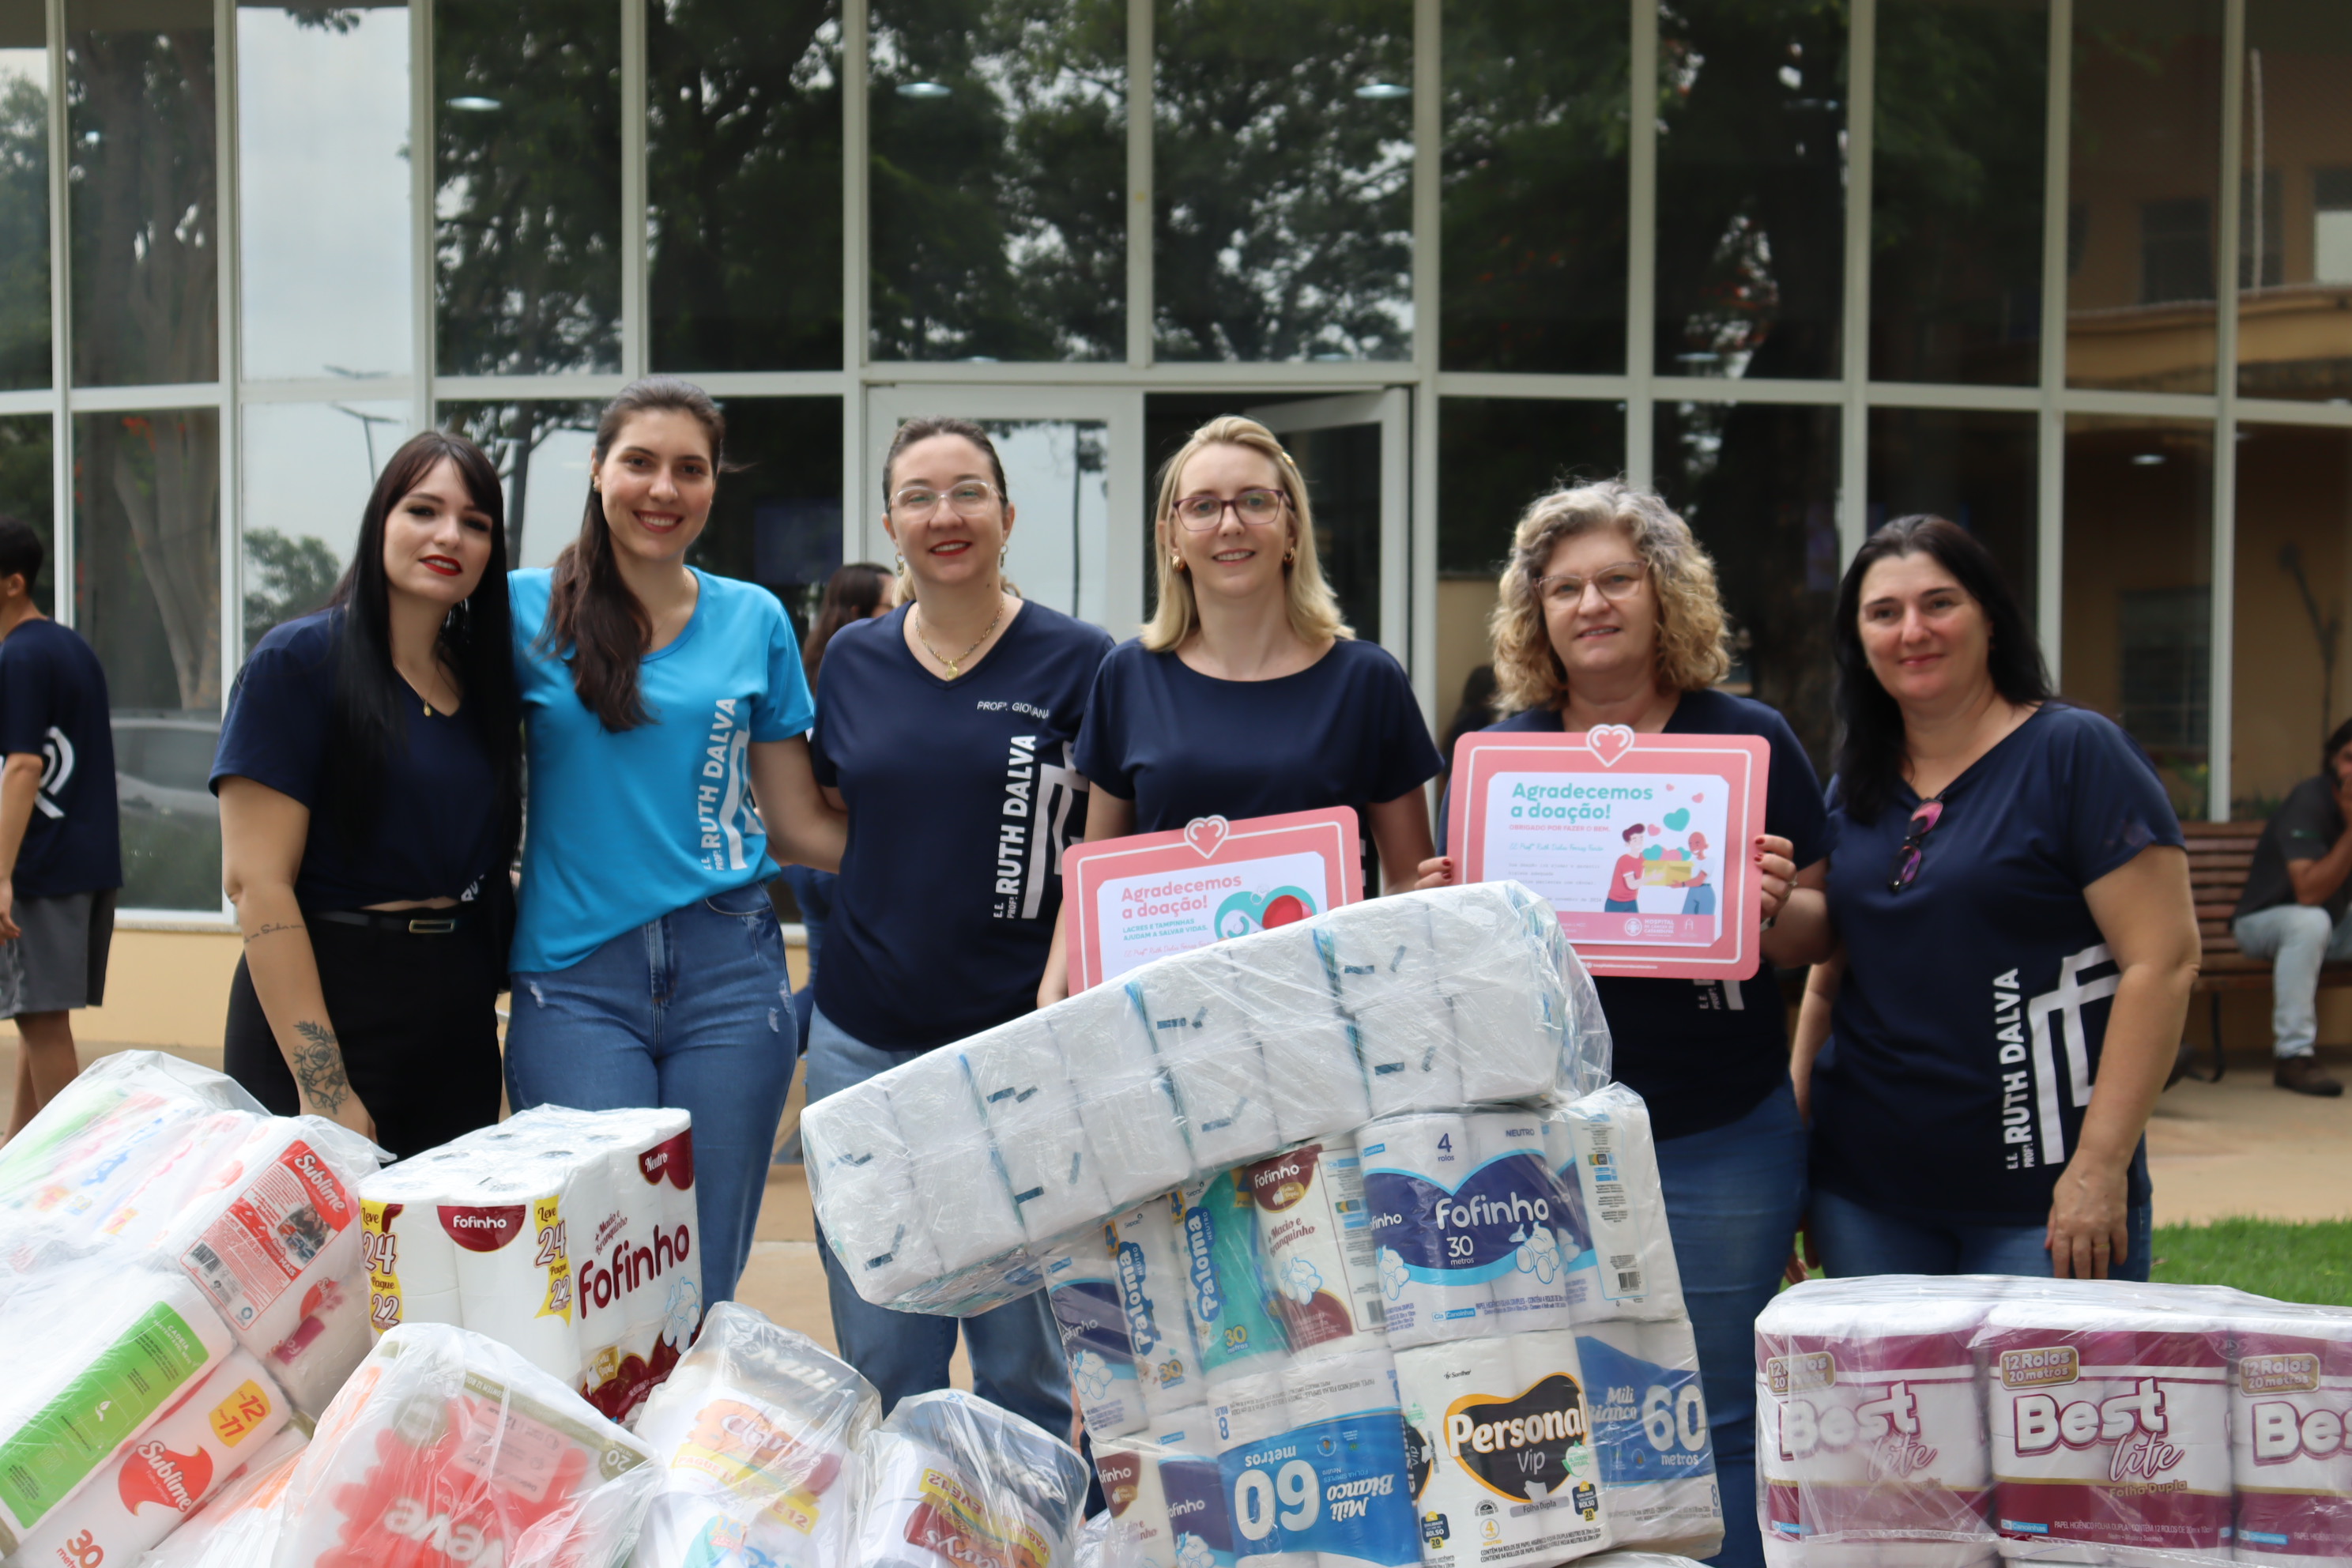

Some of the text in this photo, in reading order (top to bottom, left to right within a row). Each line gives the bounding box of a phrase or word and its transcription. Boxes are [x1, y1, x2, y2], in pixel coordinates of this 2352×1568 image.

[698, 699, 736, 848] RUTH DALVA
[1513, 782, 1653, 801] Agradecemos
[995, 736, 1036, 895] RUTH DALVA
[1510, 803, 1611, 824] a doação!
[1121, 876, 1242, 903] Agradecemos
[1122, 895, 1208, 919] a doação!
[1123, 922, 1148, 933] LACRES
[1155, 918, 1194, 929] TAMPINHAS
[1124, 932, 1151, 940] AJUDAM
[1159, 928, 1184, 937] SALVAR
[1992, 968, 2032, 1144] RUTH DALVA
[1438, 1133, 1453, 1153] 4
[1506, 1129, 1535, 1137] NEUTRO
[645, 1153, 668, 1173] Neutro
[294, 1154, 346, 1213] Sublime
[361, 1207, 379, 1226] Leve
[537, 1207, 556, 1222] Leve
[1170, 1192, 1183, 1218] 4
[1435, 1192, 1549, 1231] Fofinho
[599, 1213, 616, 1234] Macio
[1202, 1211, 1213, 1241] NEUTRO
[1271, 1217, 1302, 1240] Macio e
[536, 1219, 567, 1267] 24
[595, 1216, 628, 1256] Branquinho
[1105, 1224, 1117, 1250] 4
[1446, 1235, 1473, 1258] 30
[363, 1231, 397, 1276] 24
[1133, 1246, 1143, 1276] NEUTRO
[1450, 1257, 1474, 1266] metros
[278, 1257, 297, 1277] MAIS
[549, 1263, 567, 1276] Pague
[579, 1224, 689, 1319] Fofinho
[1188, 1215, 1218, 1319] Paloma
[371, 1276, 394, 1291] Pague
[550, 1275, 571, 1310] 22
[371, 1293, 400, 1325] 22
[1119, 1249, 1152, 1352] Paloma
[167, 1325, 190, 1351] CADEIA
[1225, 1325, 1247, 1348] 30
[1159, 1360, 1183, 1382] 30
[2003, 1351, 2071, 1371] 12 Rolos
[2243, 1358, 2311, 1378] 12 Rolos
[2009, 1367, 2068, 1382] 20 metros
[2248, 1374, 2309, 1389] 20 metros
[1606, 1385, 1635, 1404] Mili
[239, 1395, 266, 1422] 12
[1215, 1405, 1229, 1417] ROLOS
[1642, 1385, 1707, 1452] 60
[2013, 1376, 2169, 1457] Best
[219, 1415, 245, 1438] 11
[1218, 1417, 1229, 1440] 8
[1447, 1392, 1588, 1457] Personal
[1778, 1380, 1920, 1461] Best
[605, 1449, 631, 1472] 20
[1245, 1446, 1297, 1467] metros
[1517, 1449, 1545, 1475] Vip
[1661, 1453, 1699, 1466] metros
[1868, 1431, 1937, 1481] lite
[2109, 1431, 2185, 1482] lite
[136, 1440, 192, 1513] Sublime
[926, 1472, 948, 1493] 12
[1327, 1474, 1395, 1501] Bianco
[1234, 1459, 1320, 1541] 60
[1711, 1484, 1718, 1507] 8
[2109, 1479, 2188, 1498] Folha Dupla
[1330, 1497, 1370, 1522] Mili
[1523, 1501, 1556, 1513] Folha Dupla
[1579, 1500, 1595, 1509] BOLSO
[789, 1508, 809, 1528] 12
[1485, 1521, 1494, 1533] 4
[2012, 1523, 2046, 1532] Canoinhas
[2070, 1520, 2094, 1529] HIGIÊNICO
[2094, 1521, 2111, 1530] FOLHA
[2112, 1522, 2128, 1531] DUPLA
[2132, 1522, 2153, 1532] CONTÉM
[1426, 1528, 1444, 1537] BOLSO
[66, 1529, 104, 1568] 30
[1480, 1553, 1500, 1562] CONTIENE
[1481, 1547, 1498, 1555] CONTÉM
